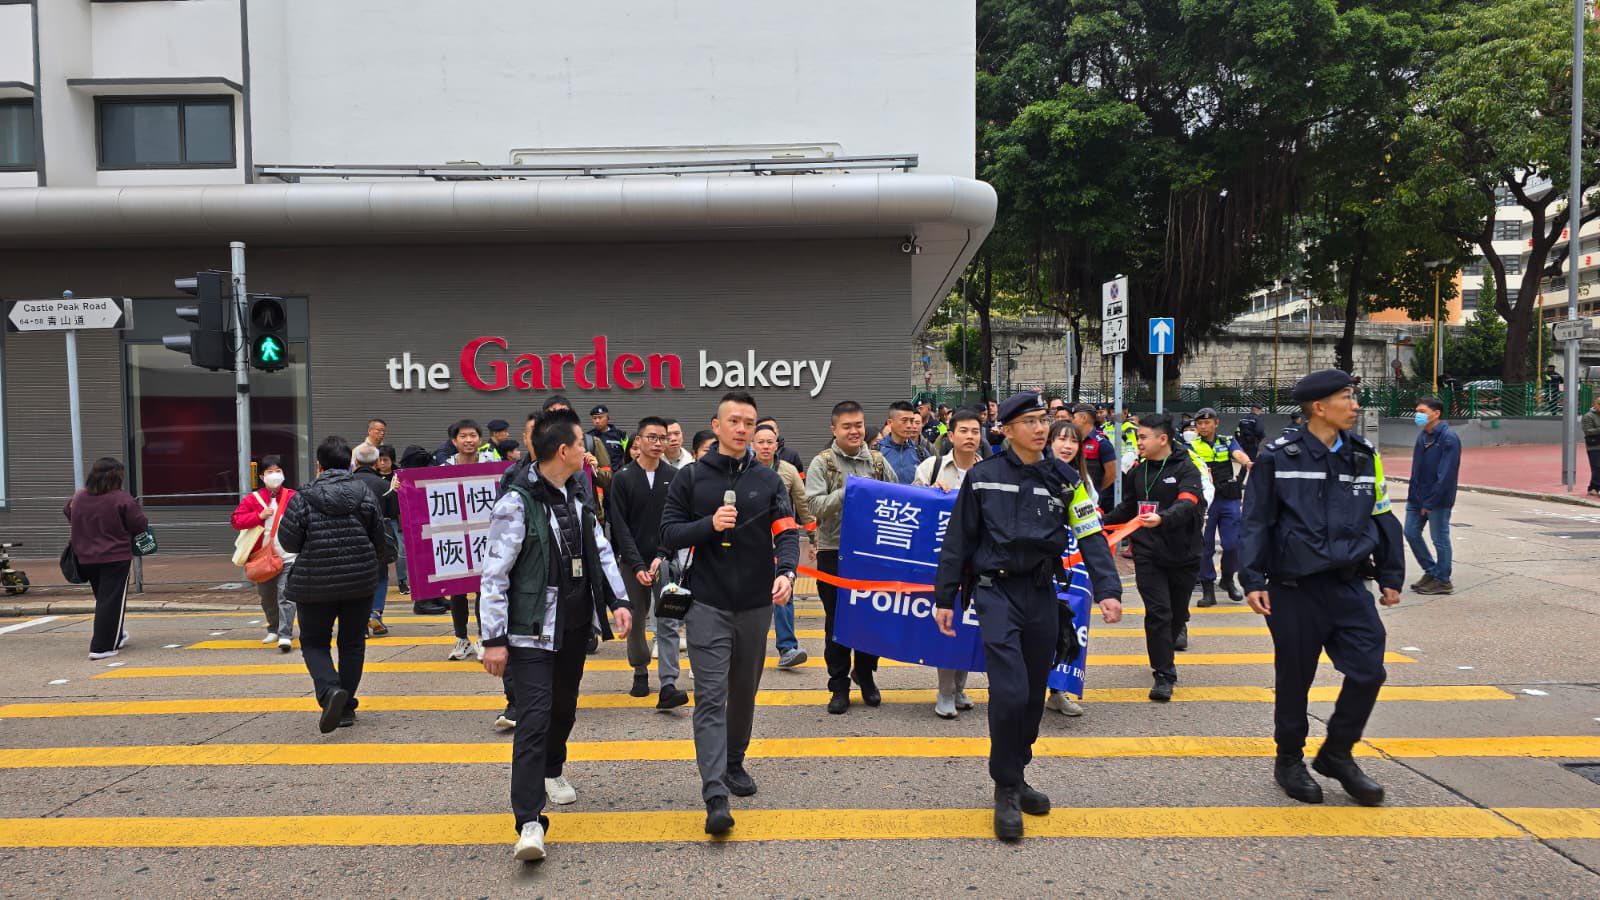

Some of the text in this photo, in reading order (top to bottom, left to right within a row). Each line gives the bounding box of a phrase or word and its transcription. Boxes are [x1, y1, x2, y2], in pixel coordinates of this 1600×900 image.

[23, 302, 107, 312] Castle Peak Road
[47, 315, 86, 326] 青山道
[1117, 319, 1123, 331] 7
[1118, 337, 1126, 350] 12
[386, 335, 832, 397] the Garden bakery
[429, 486, 495, 517] 加快
[849, 588, 938, 618] Polic
